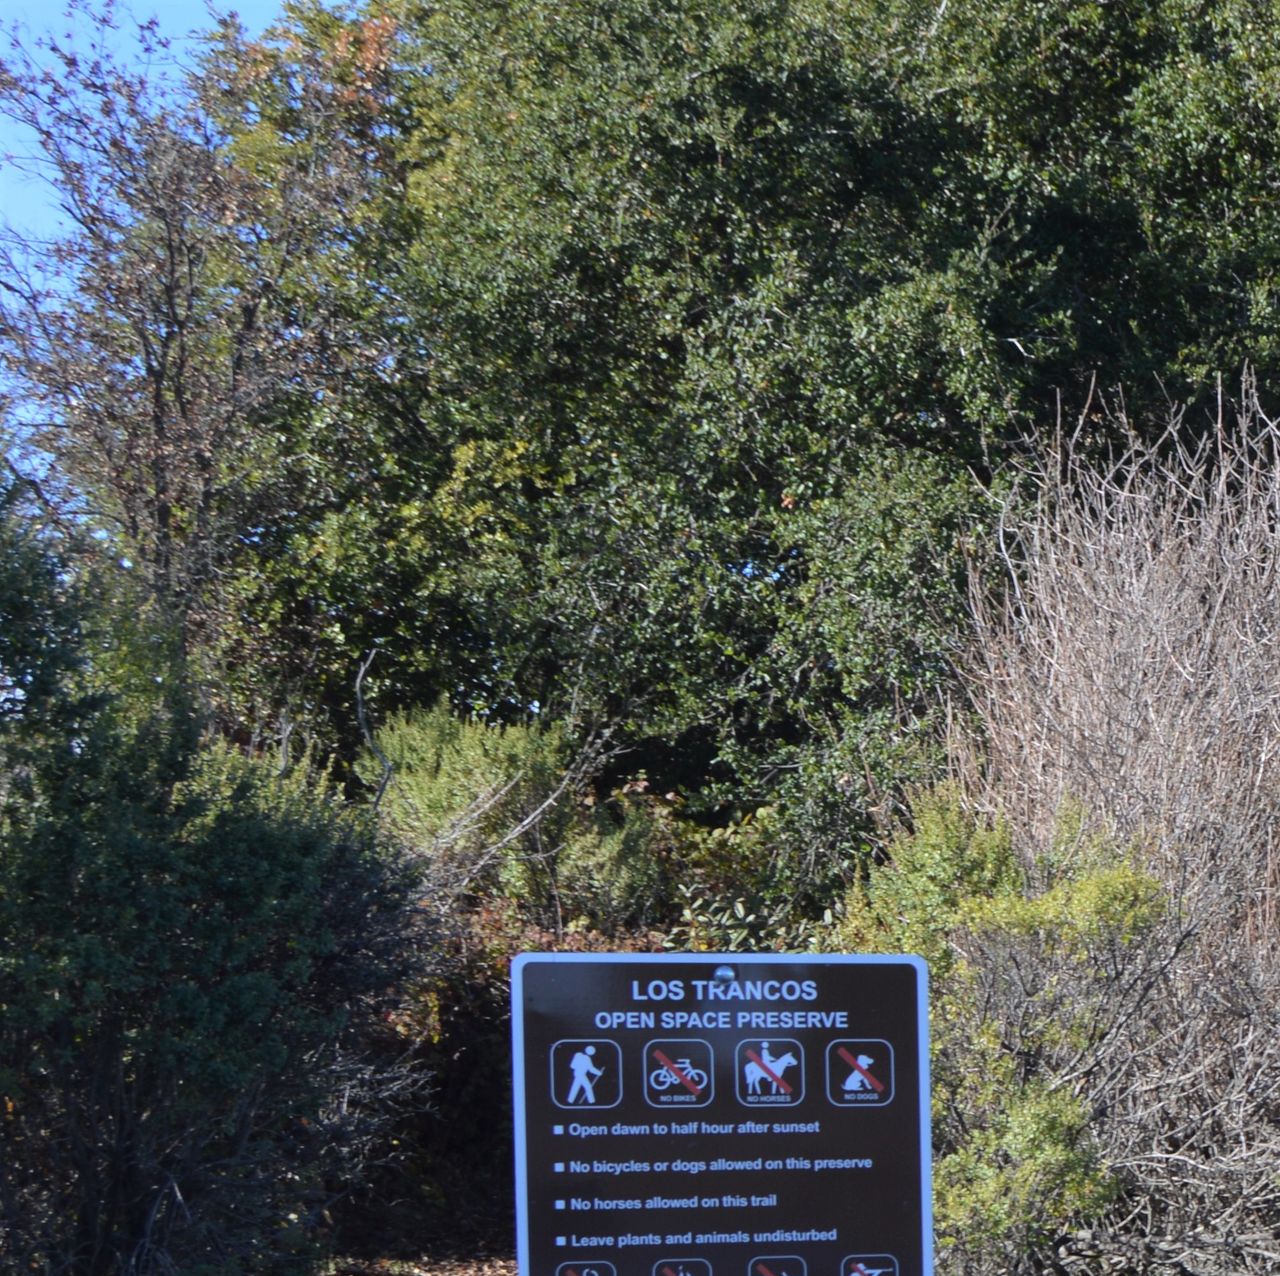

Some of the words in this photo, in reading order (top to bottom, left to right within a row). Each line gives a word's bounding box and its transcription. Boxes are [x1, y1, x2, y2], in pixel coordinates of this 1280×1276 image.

[632, 979, 684, 1001] LOS
[693, 979, 817, 1001] TRANCOS
[595, 1012, 654, 1028] OPEN
[662, 1012, 731, 1028] SPACE
[737, 1012, 848, 1028] PRESERVE
[569, 1123, 607, 1137] Open
[612, 1123, 649, 1135] dawn
[653, 1124, 667, 1134] to
[671, 1122, 698, 1134] half
[701, 1122, 733, 1133] hour
[738, 1121, 768, 1133] after
[773, 1122, 820, 1132] sunset
[570, 1161, 590, 1172] No
[593, 1161, 650, 1175] bicycles
[654, 1162, 668, 1171] or
[672, 1160, 706, 1173] dogs
[710, 1158, 762, 1170] allowed
[765, 1160, 782, 1169] on
[786, 1158, 810, 1169] this
[814, 1159, 873, 1171] preserve
[570, 1198, 591, 1210] No
[594, 1198, 642, 1209] horses
[646, 1196, 698, 1208] allowed
[702, 1198, 719, 1207] on
[722, 1195, 747, 1207] this
[751, 1195, 777, 1206] trail
[571, 1235, 614, 1246] Leave
[618, 1234, 661, 1248] plants
[666, 1232, 692, 1244] and
[696, 1231, 750, 1243] animals
[754, 1229, 837, 1242] undisturbed
